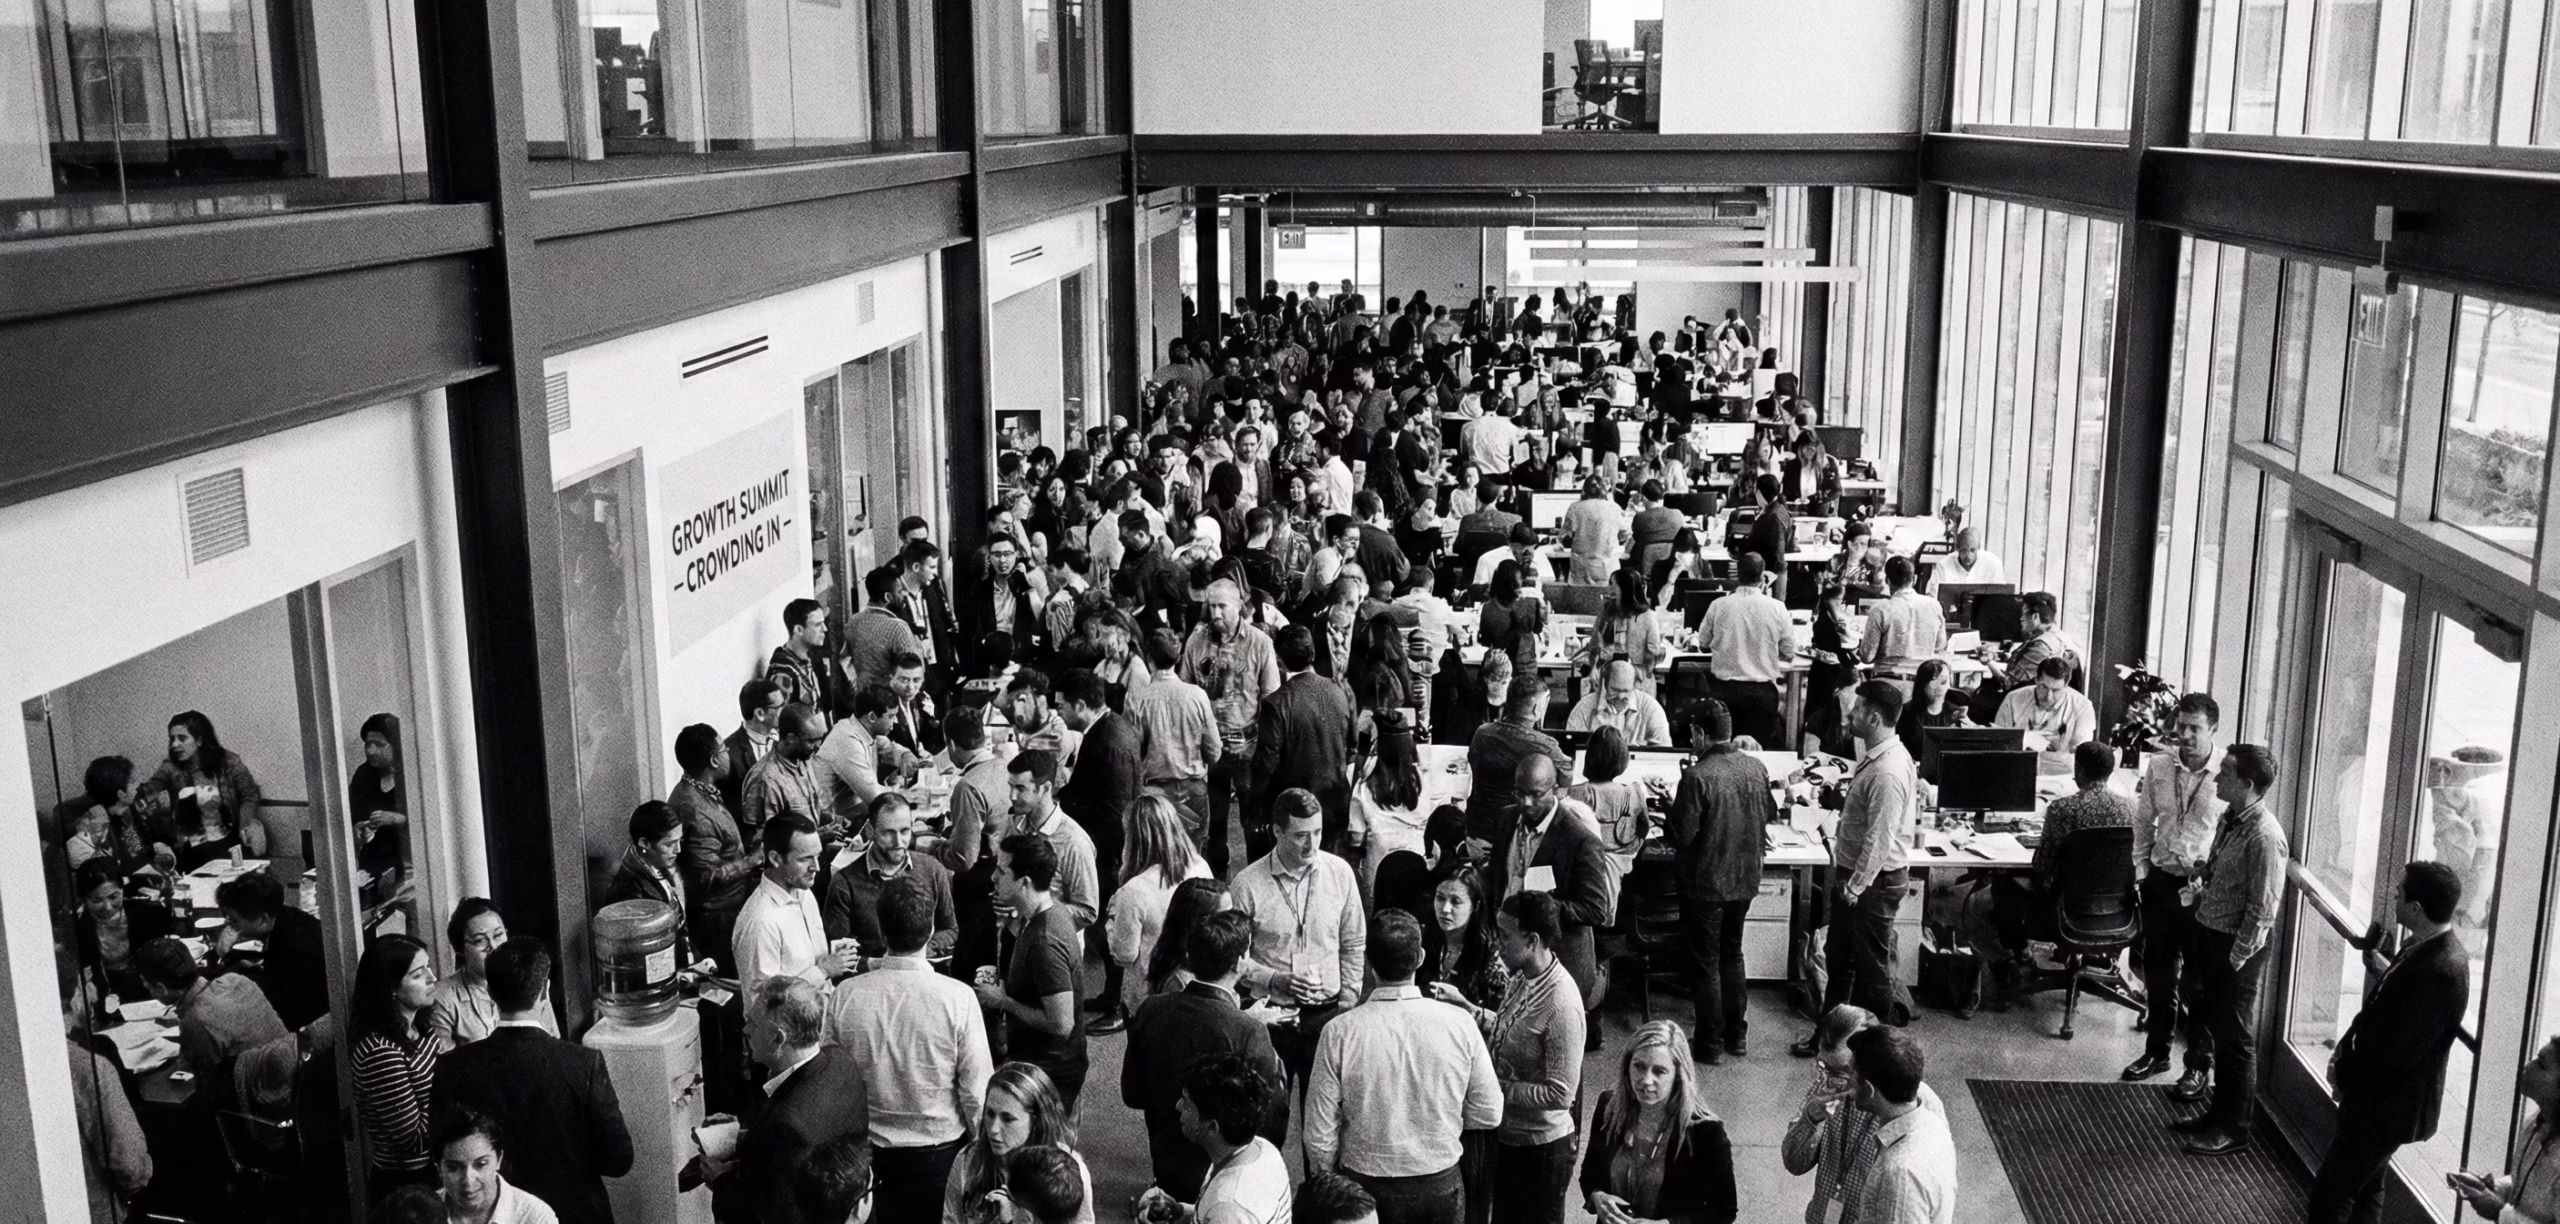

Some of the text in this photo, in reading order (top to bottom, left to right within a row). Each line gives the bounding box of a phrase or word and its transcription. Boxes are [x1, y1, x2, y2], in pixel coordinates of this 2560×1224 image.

[672, 468, 790, 556] GROWTH SUMMIT
[686, 524, 764, 593] CROWDING
[767, 514, 781, 547] IN
